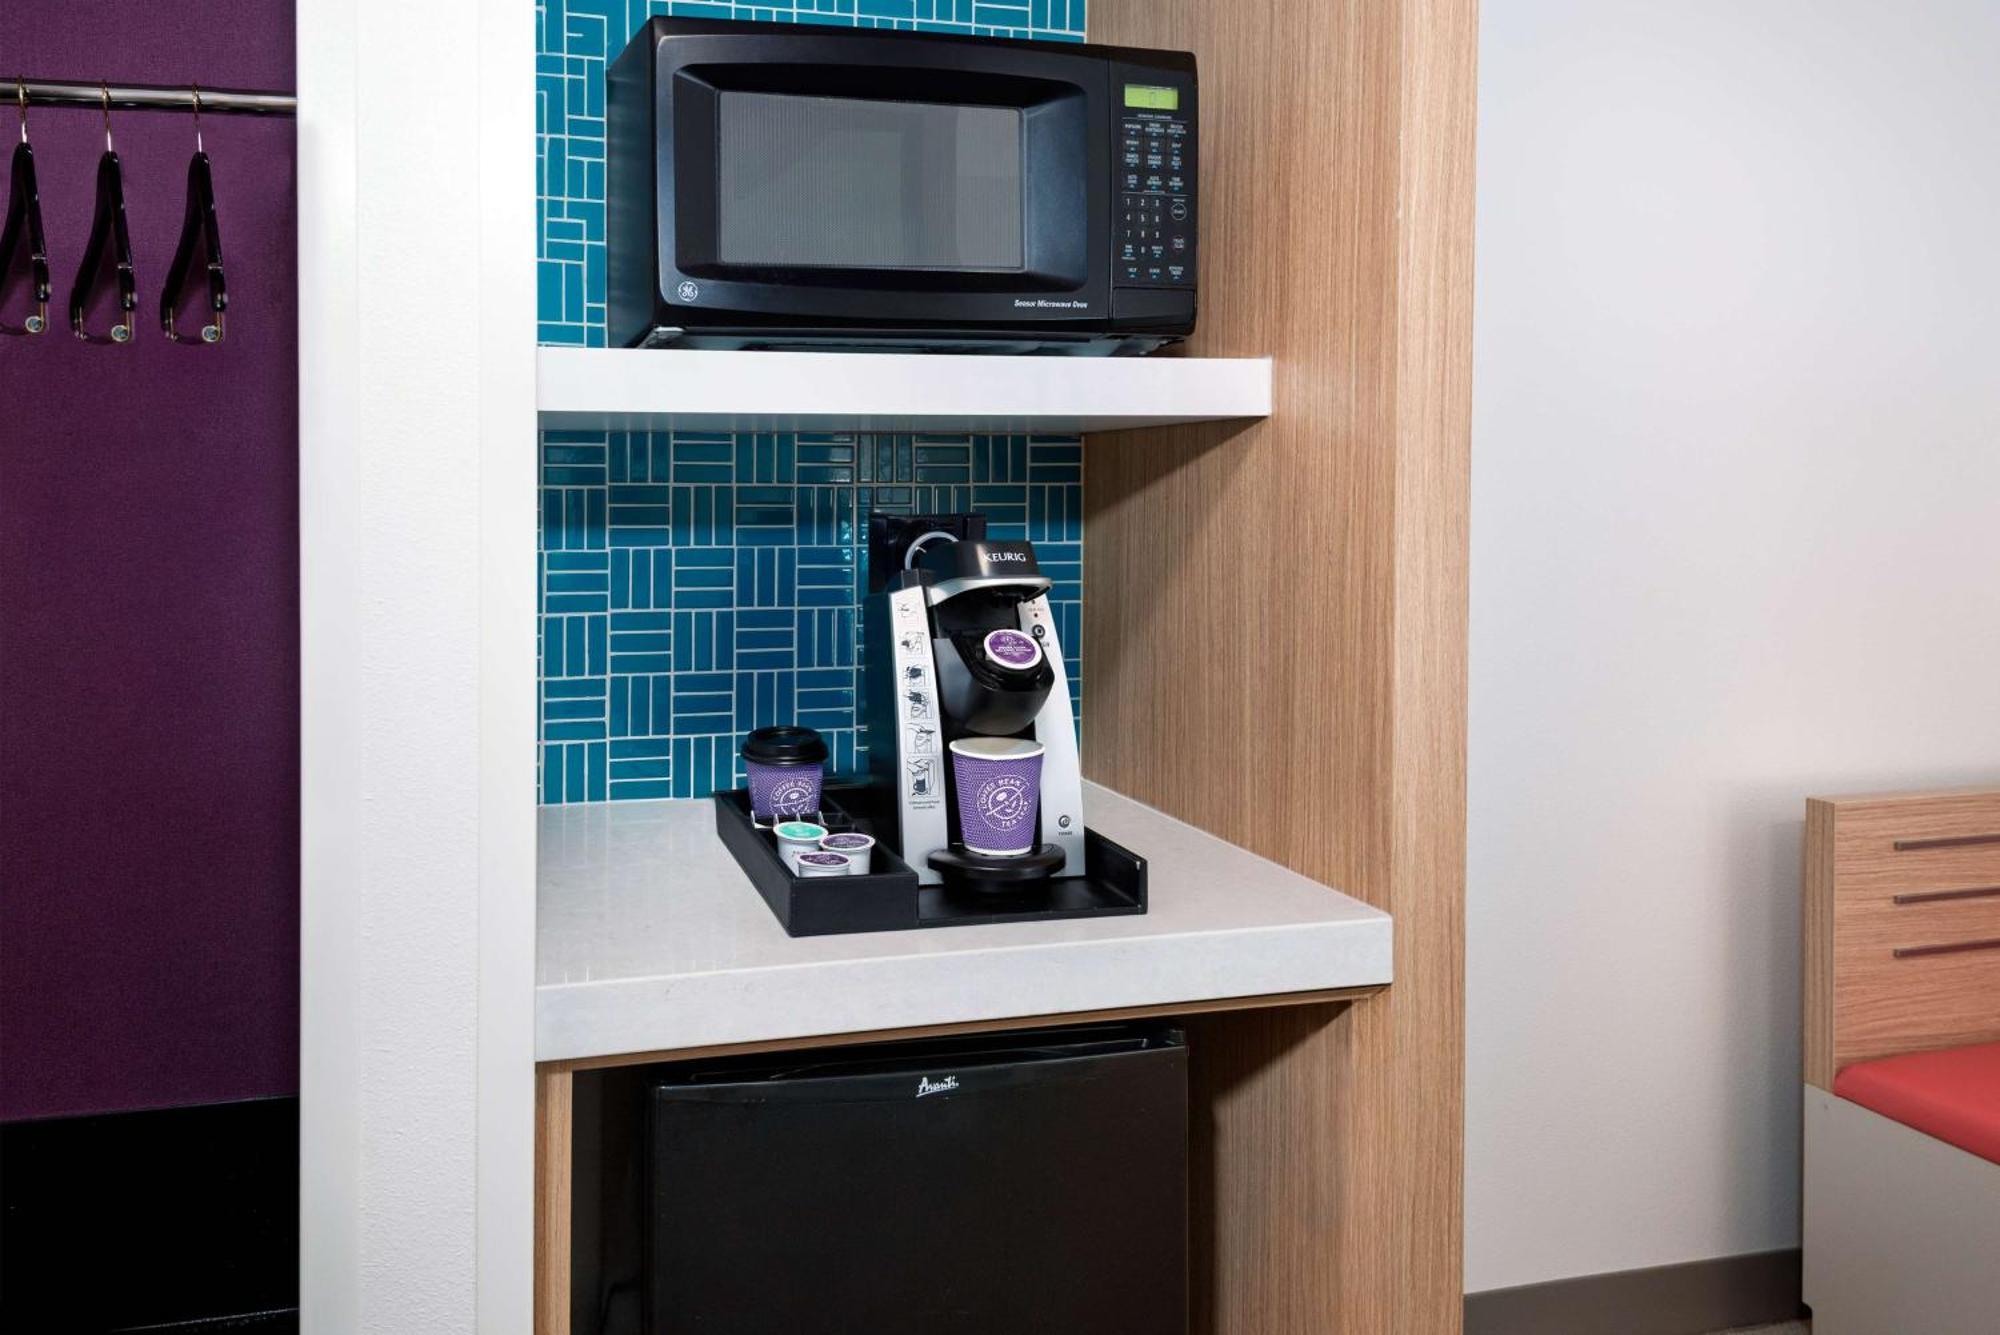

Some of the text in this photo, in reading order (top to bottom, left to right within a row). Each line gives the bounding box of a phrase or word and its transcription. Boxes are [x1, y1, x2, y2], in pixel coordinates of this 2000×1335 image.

[1014, 299, 1036, 308] Sensor
[1037, 299, 1071, 308] Microwave
[982, 552, 1026, 562] KEURIG
